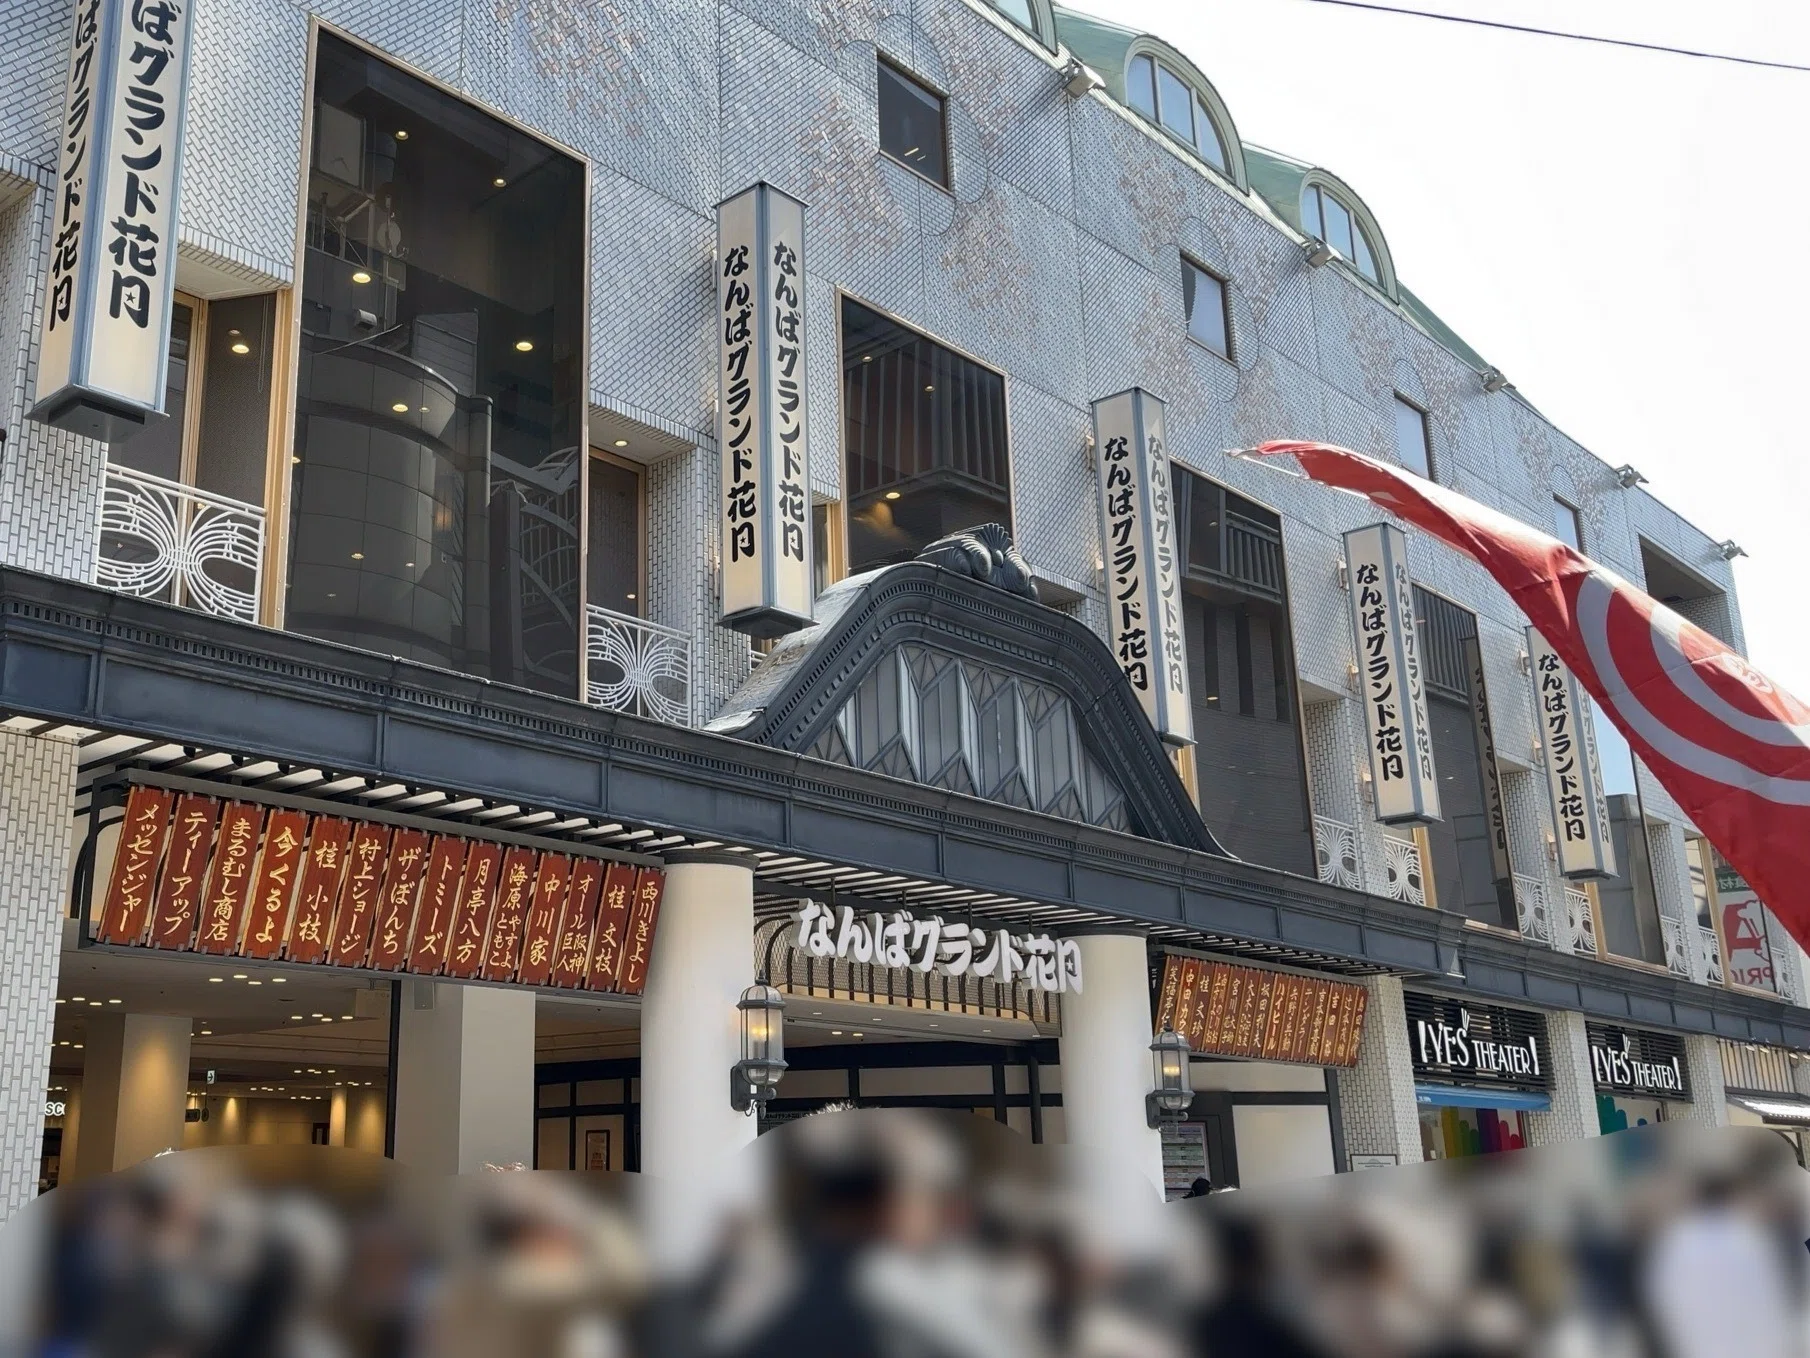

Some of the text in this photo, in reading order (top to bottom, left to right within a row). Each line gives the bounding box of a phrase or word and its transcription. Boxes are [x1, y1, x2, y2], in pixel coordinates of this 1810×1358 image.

[49, 0, 99, 332] ばグランド花月
[724, 244, 757, 563] なんばグランド花月
[774, 240, 805, 563] なんばグランド花月
[1104, 436, 1148, 692] なんばグランド花月
[1148, 433, 1184, 694] なんばグランド花月
[1356, 563, 1404, 781] なんばグランド花月
[1395, 561, 1432, 781] なんばグランド花月
[1538, 653, 1586, 842] なんばグランド花月
[119, 804, 159, 932] メッセンジャー
[164, 811, 208, 936] ティーアップ
[204, 818, 252, 942] まるむし商店
[255, 826, 299, 944] 今くるよ
[341, 837, 382, 954] 村上ショージ
[383, 846, 421, 955] ザ・ぼんち
[419, 855, 453, 955] トミーズ
[456, 858, 491, 964] 月亭八方
[530, 873, 560, 966] 中川家
[628, 882, 659, 983] 西川きよし
[790, 898, 1083, 995] なんばグランド花月
[1160, 965, 1178, 1033] 笑福亭仁
[1178, 969, 1195, 1035] 中田カウ
[1267, 983, 1285, 1050] ハイヒール
